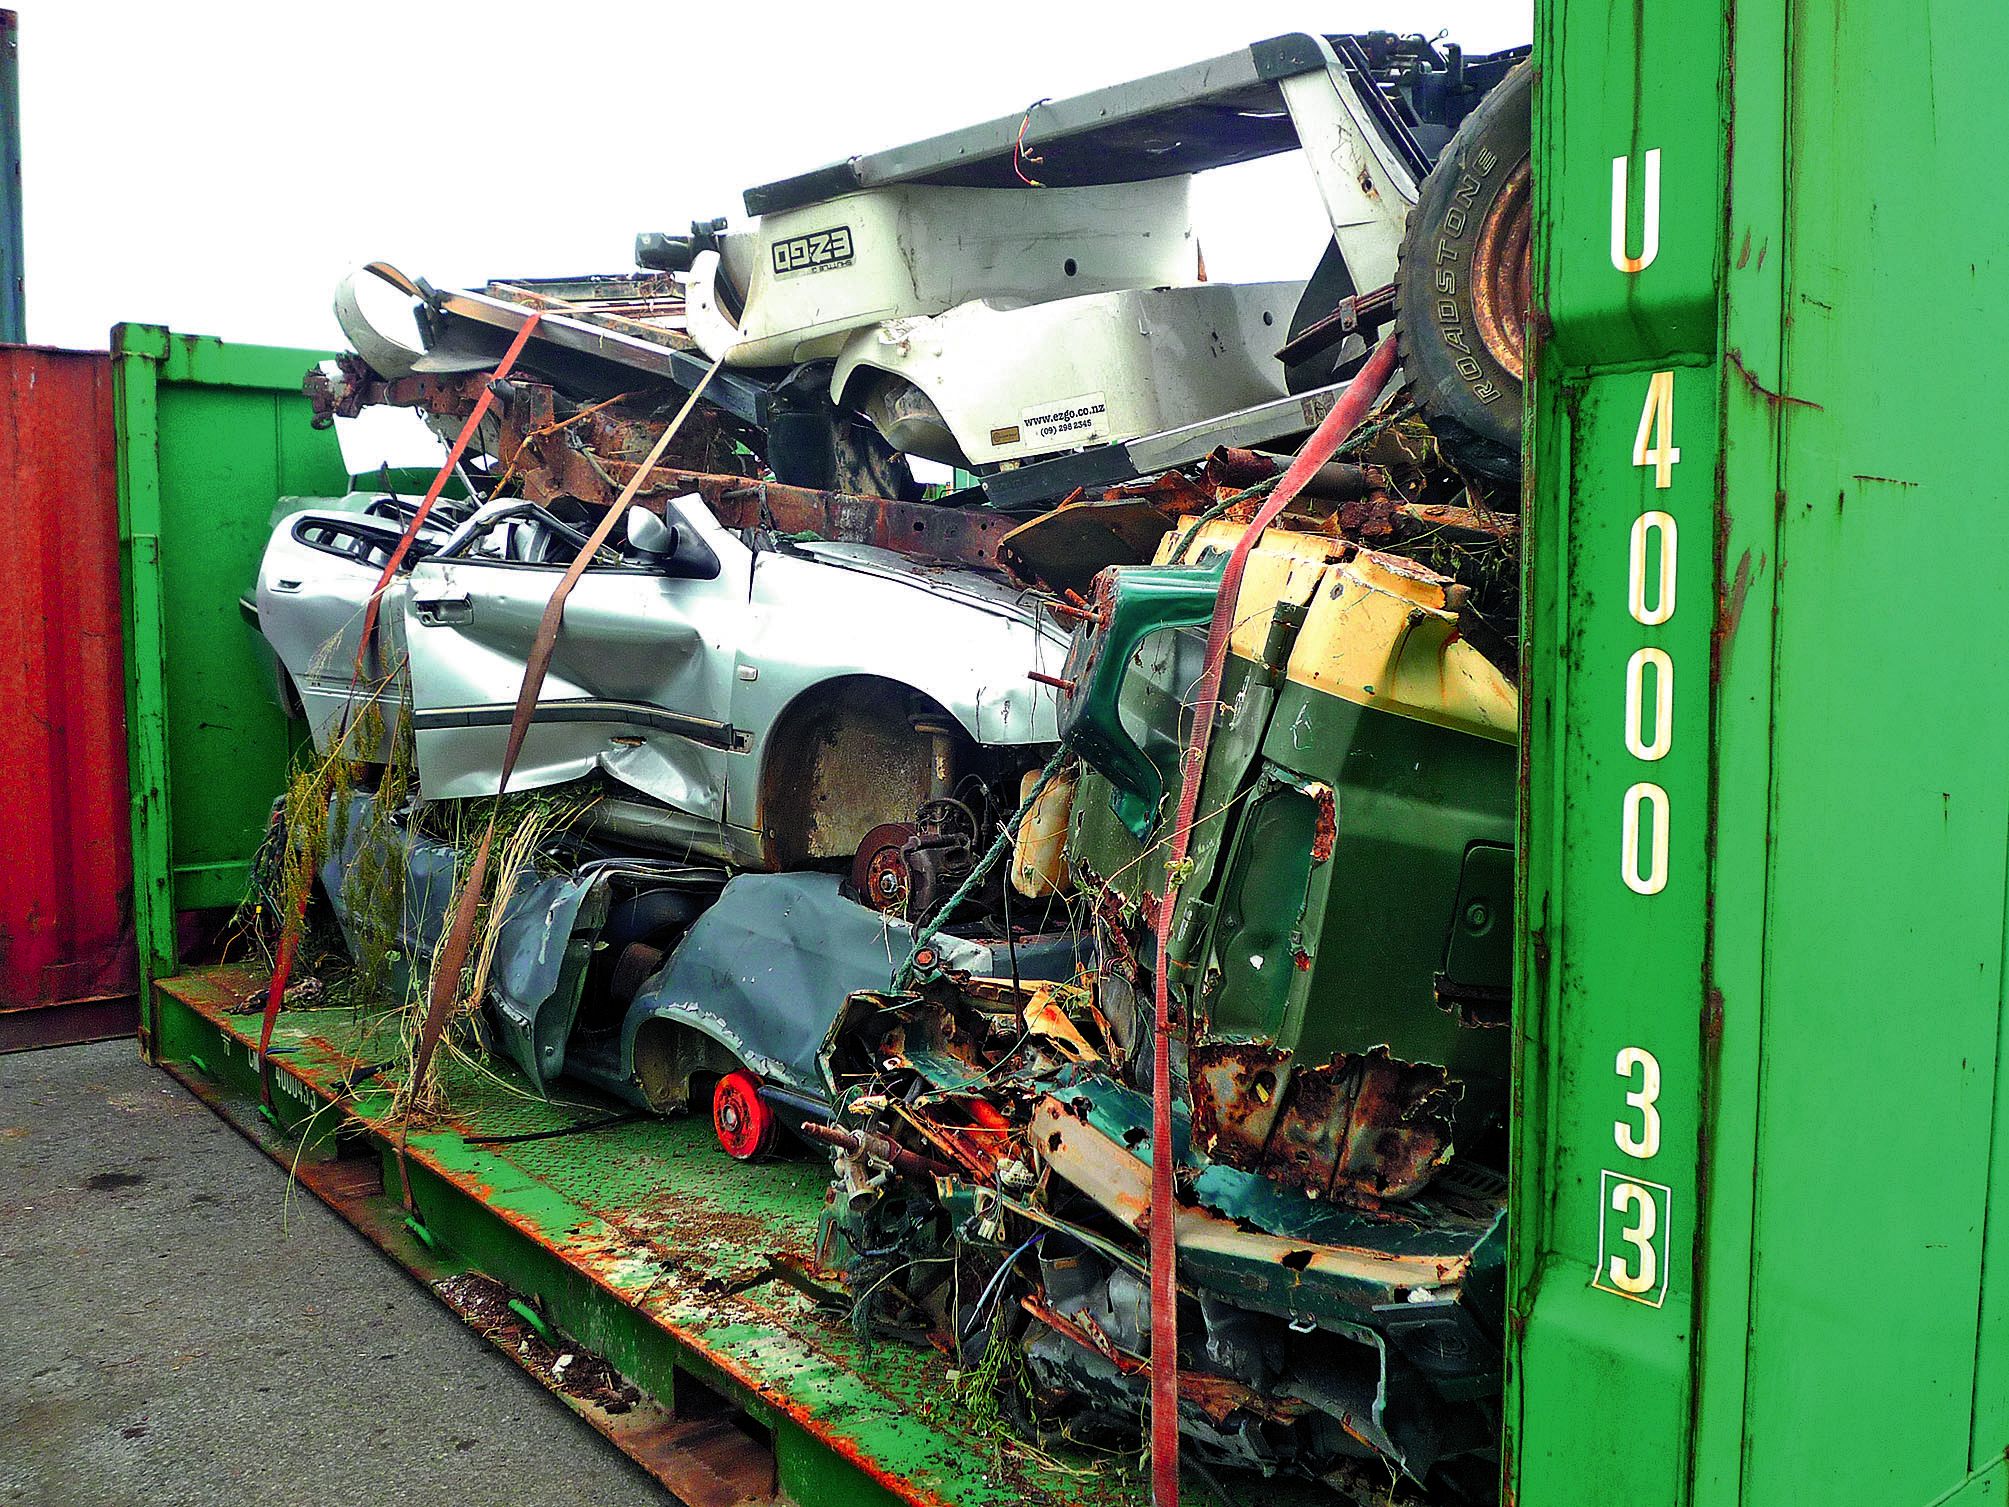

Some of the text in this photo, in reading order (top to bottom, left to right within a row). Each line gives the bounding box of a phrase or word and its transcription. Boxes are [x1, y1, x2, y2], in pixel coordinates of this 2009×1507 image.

[1611, 149, 1660, 272] U
[773, 229, 852, 270] EZGO
[1435, 147, 1503, 405] ROADSTONE
[1024, 403, 1105, 428] www.ezgo.co.nz
[1040, 426, 1057, 438] (09)
[1073, 419, 1092, 430] 2345
